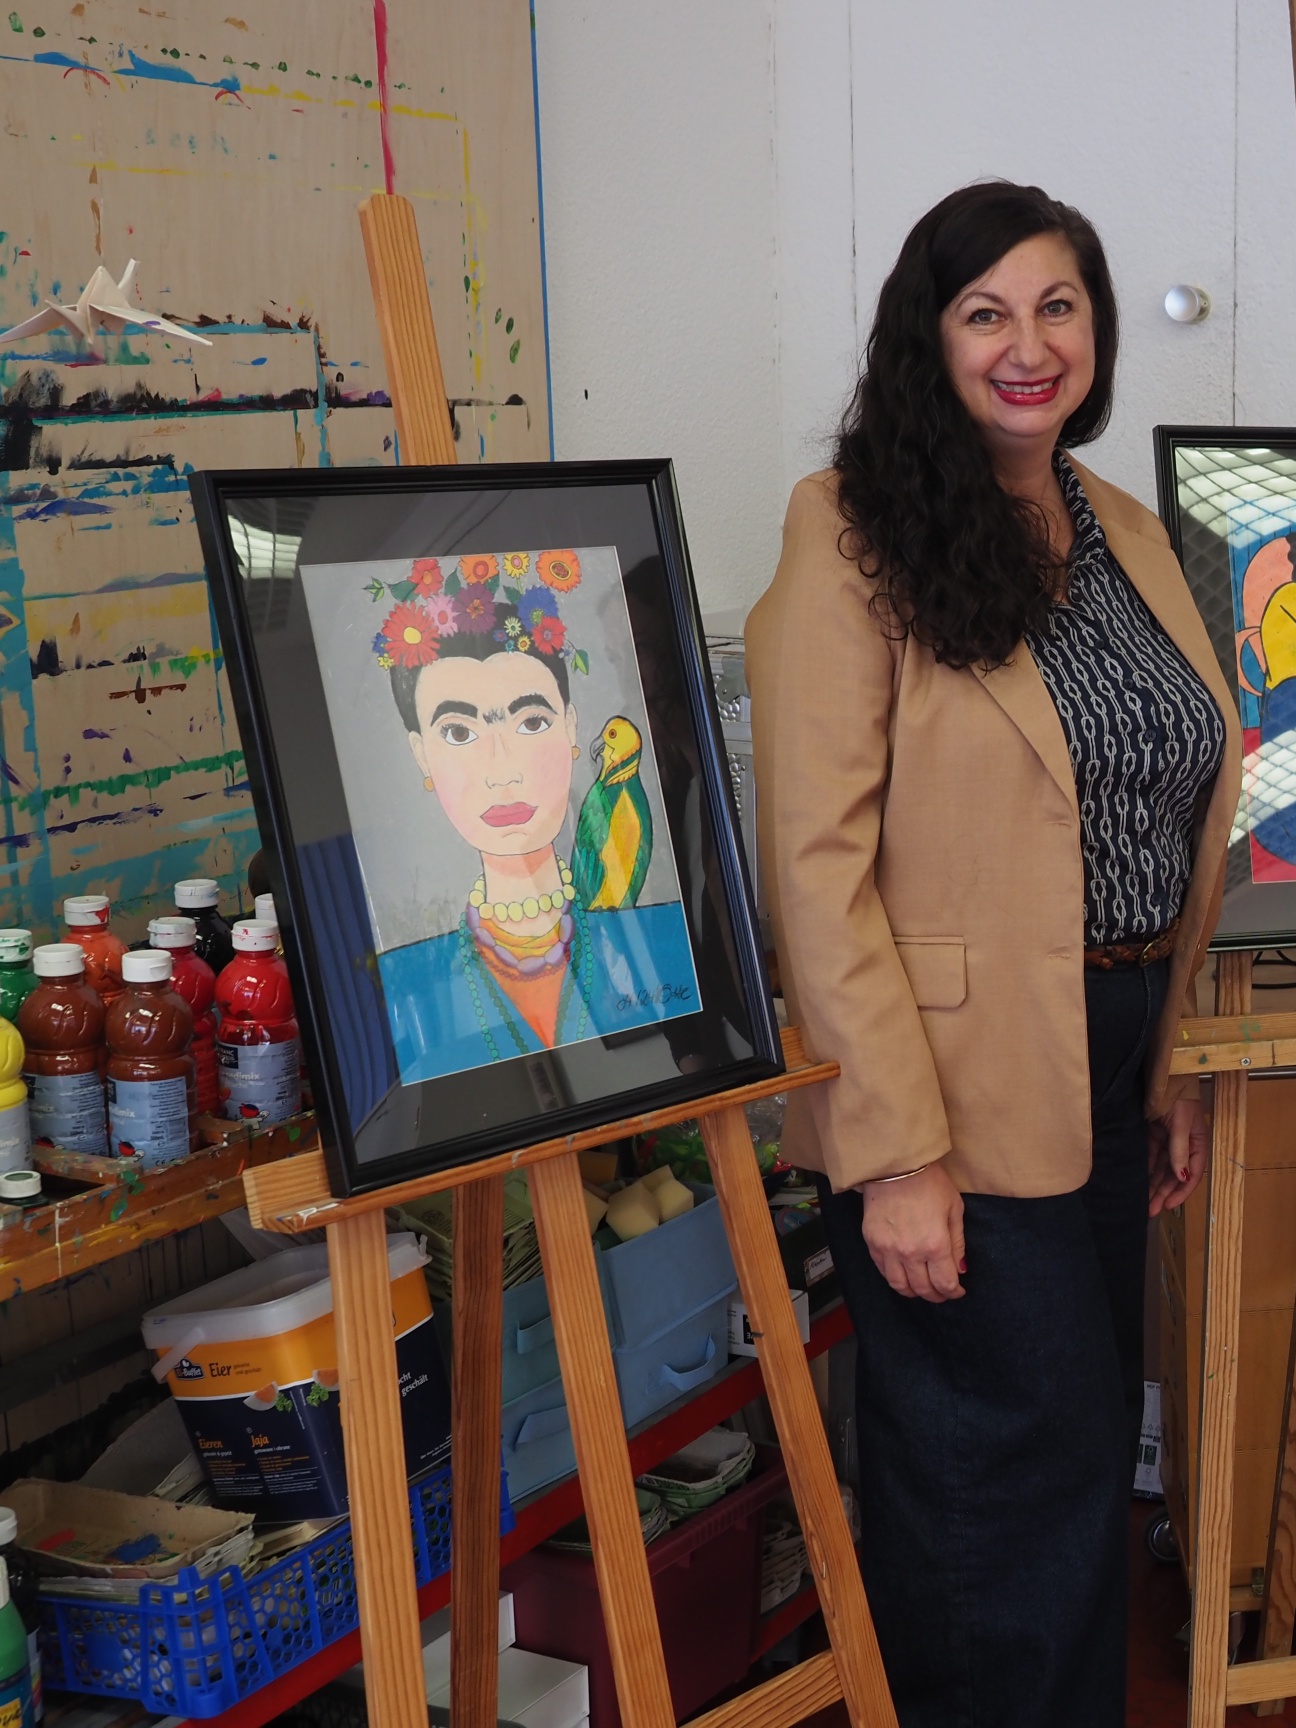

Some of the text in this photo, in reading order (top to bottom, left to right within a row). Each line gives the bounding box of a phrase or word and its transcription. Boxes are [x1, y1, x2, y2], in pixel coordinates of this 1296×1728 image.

[208, 1362, 232, 1378] Eier
[401, 1374, 428, 1397] geschält
[251, 1434, 269, 1448] Jaja
